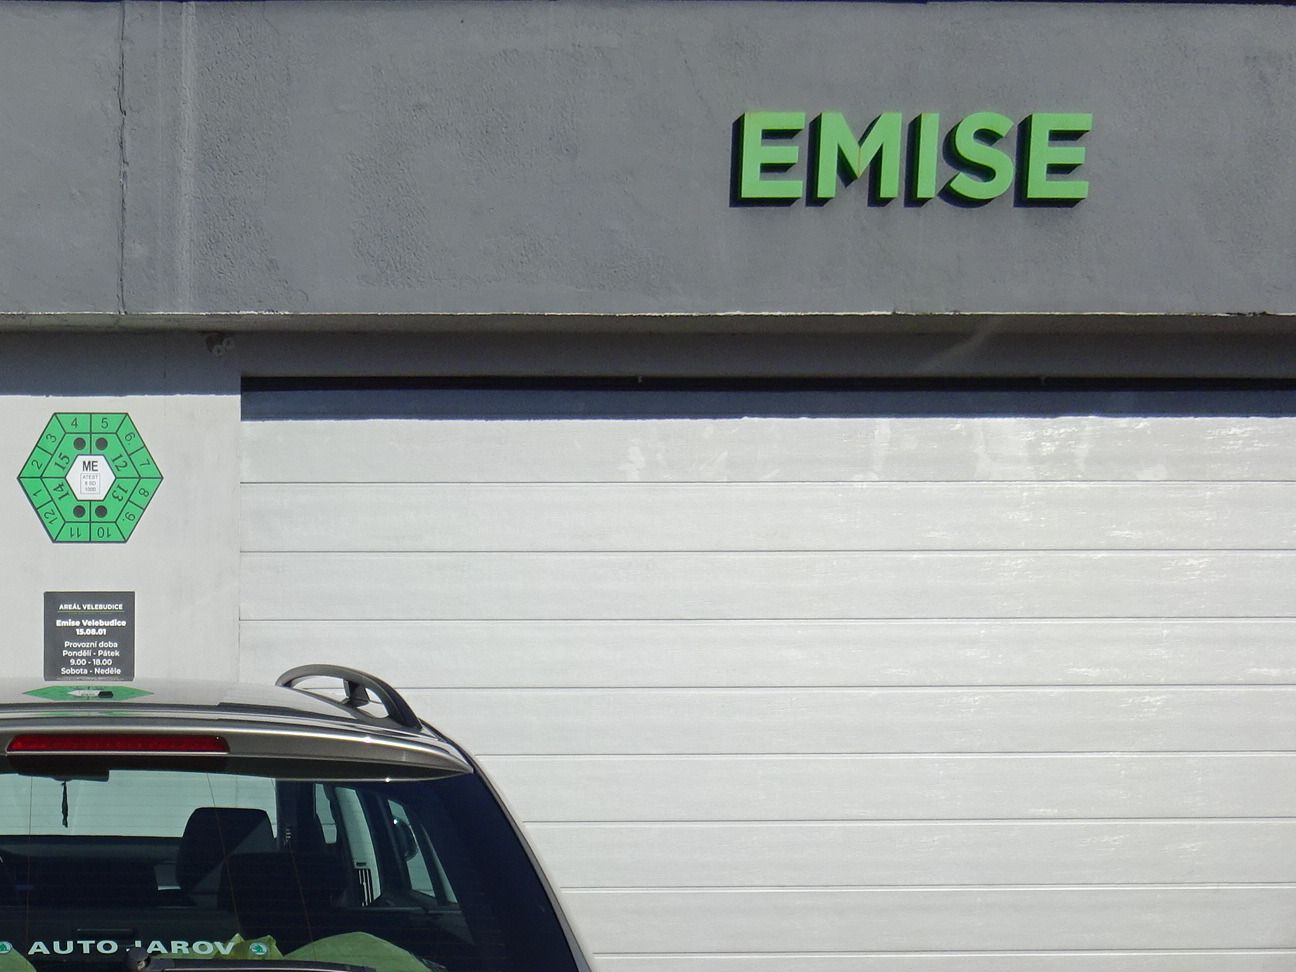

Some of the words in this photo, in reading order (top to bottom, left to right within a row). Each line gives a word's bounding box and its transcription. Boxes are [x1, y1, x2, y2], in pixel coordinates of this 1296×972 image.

[738, 111, 1094, 202] EMISE
[70, 417, 79, 428] 4
[101, 417, 109, 429] 5
[45, 432, 57, 443] 3
[31, 459, 43, 470] 2
[54, 452, 70, 471] 15
[82, 460, 99, 472] ME
[111, 453, 128, 472] 12
[139, 458, 151, 468] 7
[32, 488, 42, 497] 1
[53, 481, 70, 500] 14
[112, 484, 129, 502] 13
[138, 487, 150, 497] 8
[43, 508, 58, 525] 12
[69, 526, 81, 538] 11
[96, 526, 112, 538] 10
[55, 618, 81, 627] Emise
[82, 618, 127, 627] Velebudice
[75, 628, 107, 636] 15.08.01
[64, 640, 98, 648] Provozní
[98, 640, 118, 648] doba
[62, 649, 92, 657] Pondělí
[97, 649, 120, 657] Pátek
[69, 658, 87, 666] 9.00
[92, 658, 113, 666] 18.00
[60, 667, 88, 675] Sobota
[94, 667, 122, 675] Neděle
[27, 940, 119, 955] AUTO
